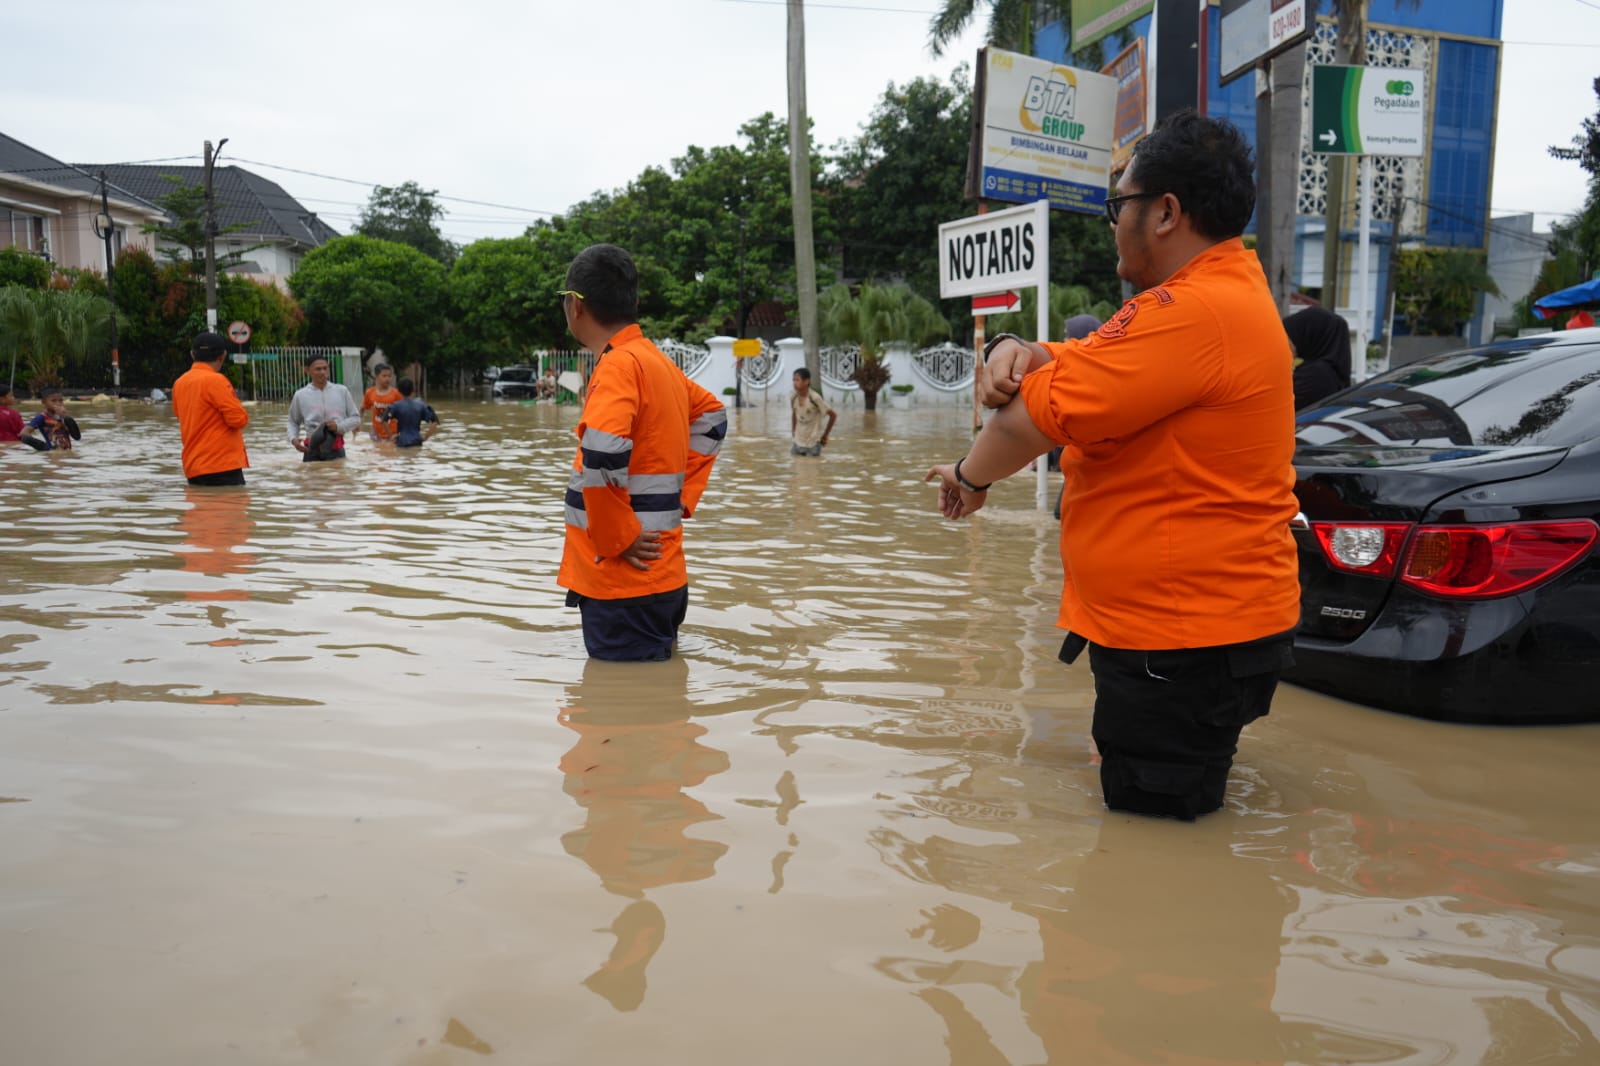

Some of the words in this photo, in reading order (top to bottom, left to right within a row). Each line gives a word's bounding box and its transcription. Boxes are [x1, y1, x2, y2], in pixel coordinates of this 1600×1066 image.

[1024, 75, 1077, 119] BTA
[1374, 96, 1420, 110] Pegadaian
[1042, 115, 1085, 142] GROUP
[1010, 136, 1055, 154] BIMBINGAN
[1056, 145, 1088, 161] BELAJAR
[949, 222, 1035, 282] NOTARIS
[1320, 605, 1366, 619] 250G
